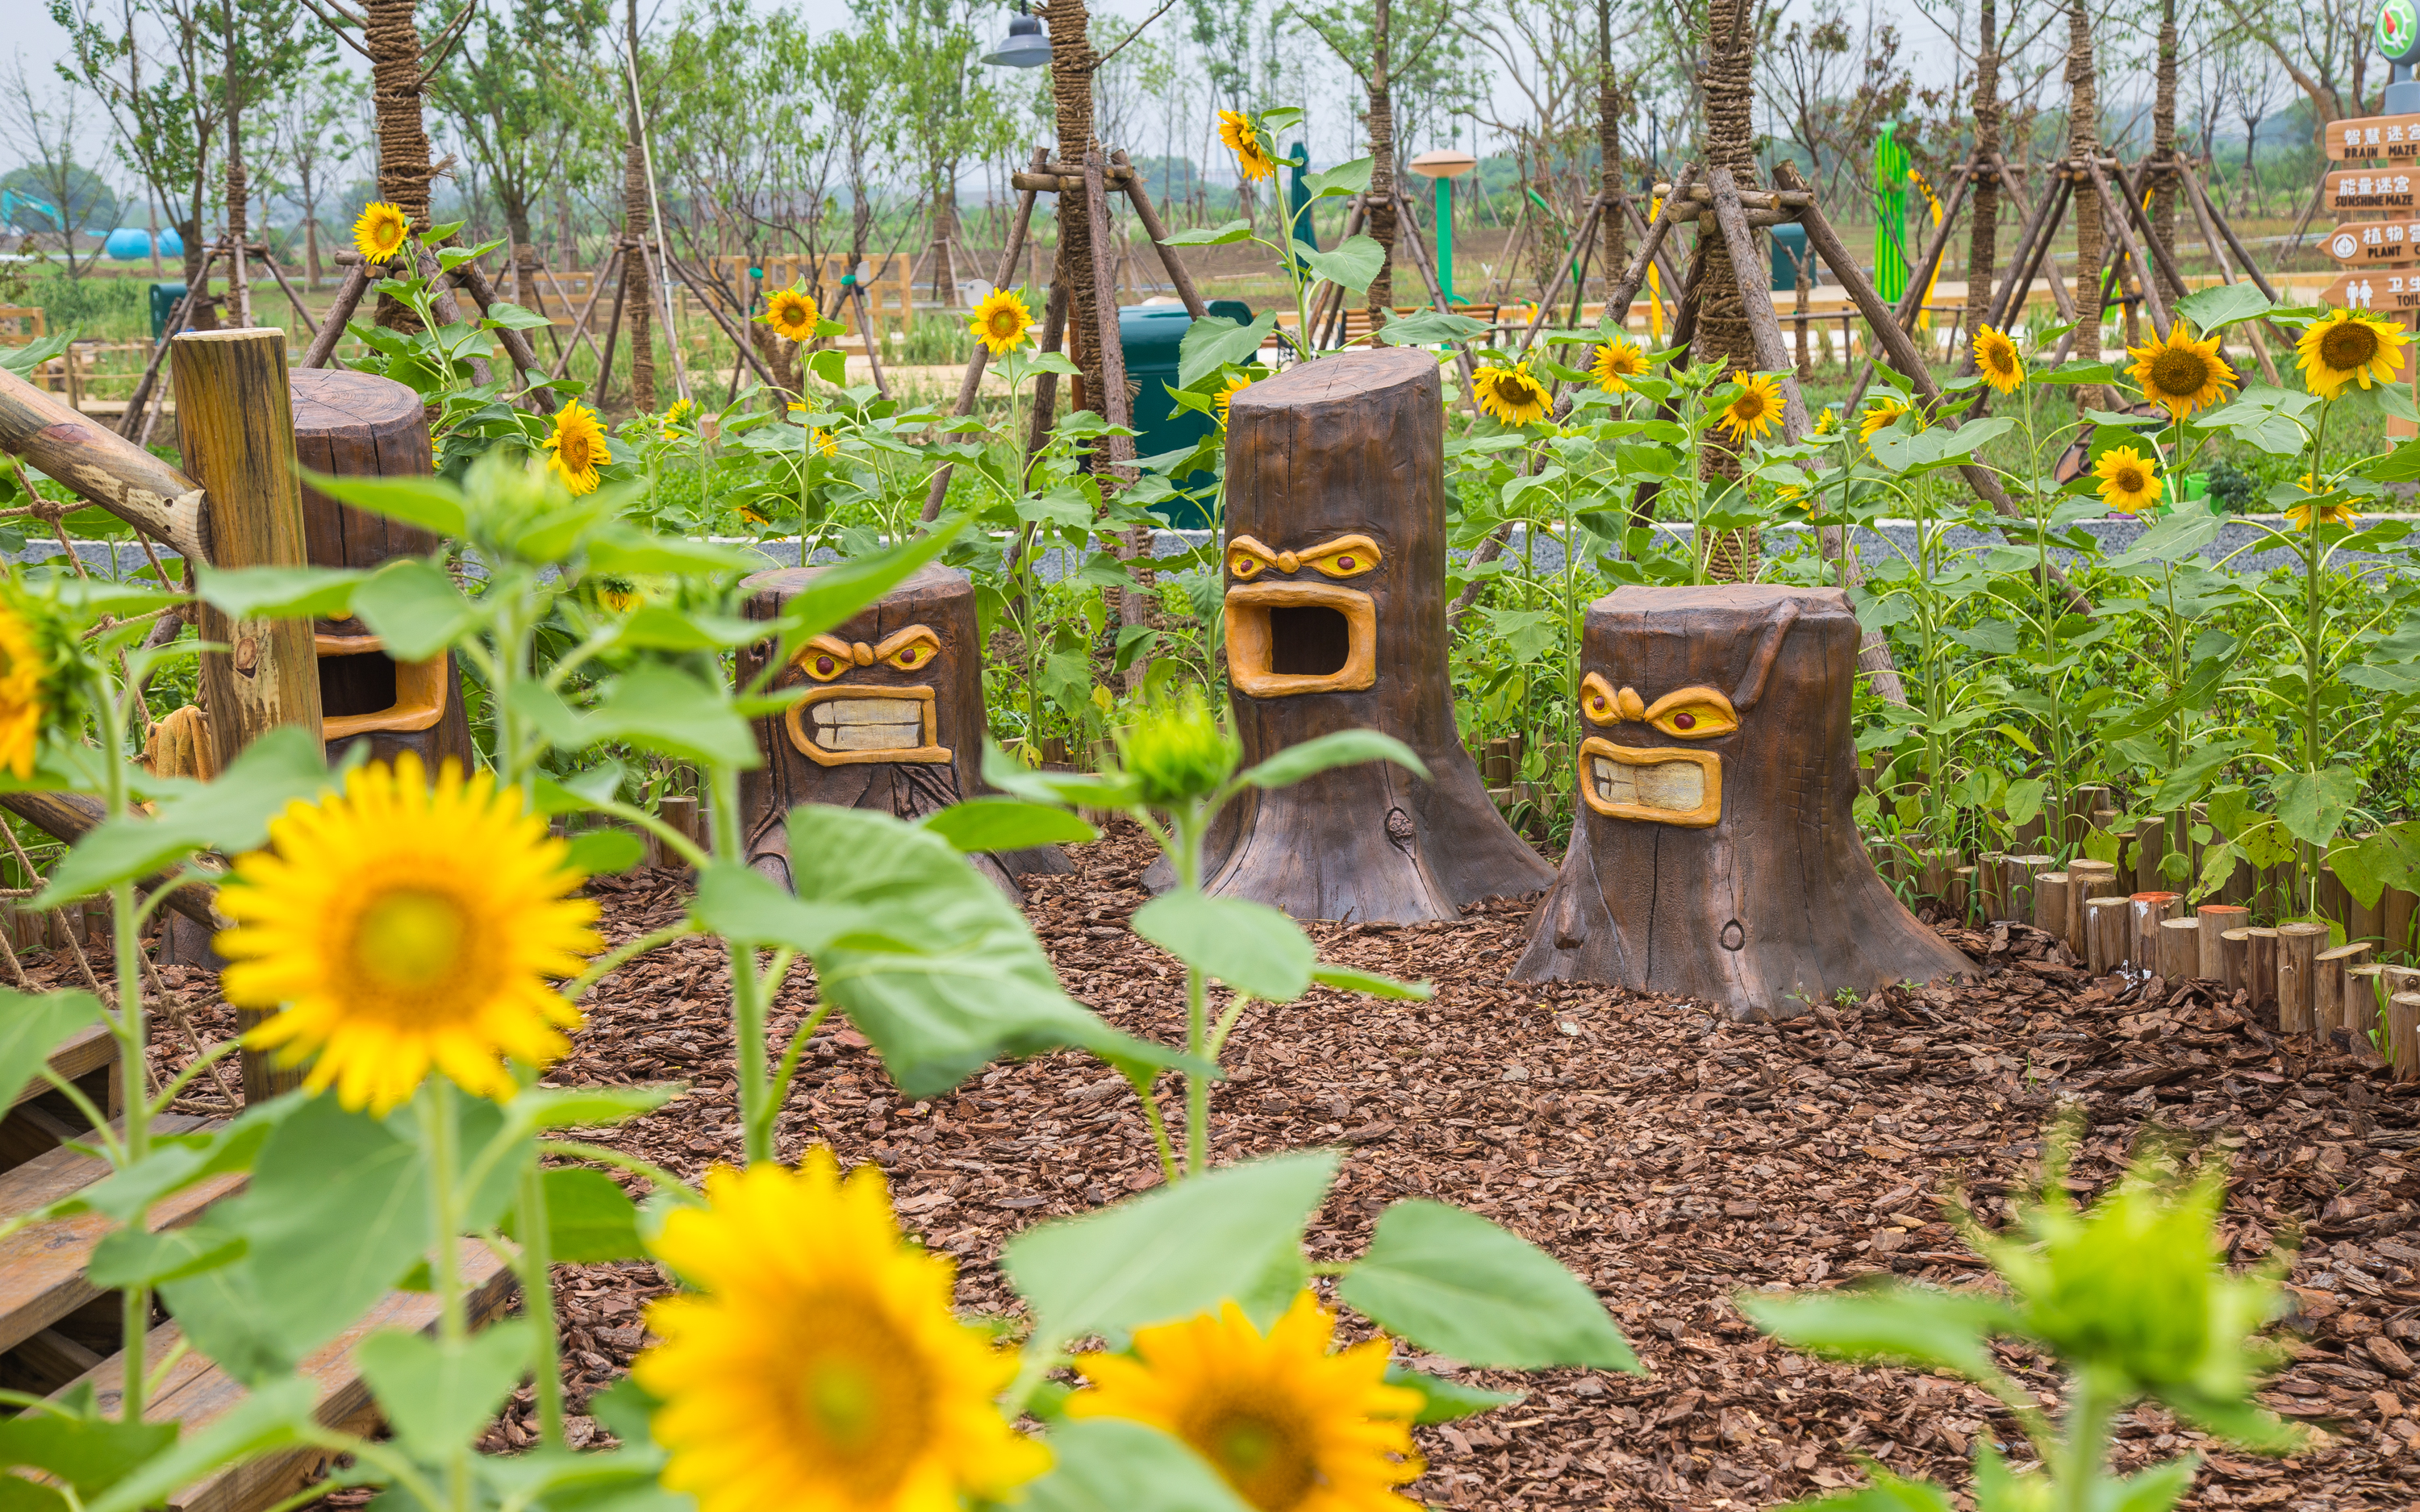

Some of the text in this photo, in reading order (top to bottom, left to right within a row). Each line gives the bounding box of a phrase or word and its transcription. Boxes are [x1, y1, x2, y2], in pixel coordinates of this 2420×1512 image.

[2344, 123, 2420, 146] 智慧迷宫
[2344, 144, 2418, 158] BRAIN MAZE
[2339, 175, 2410, 197] 能量迷宫
[2335, 194, 2414, 207] SUNSHINE MAZE
[2368, 245, 2401, 258] PLANT
